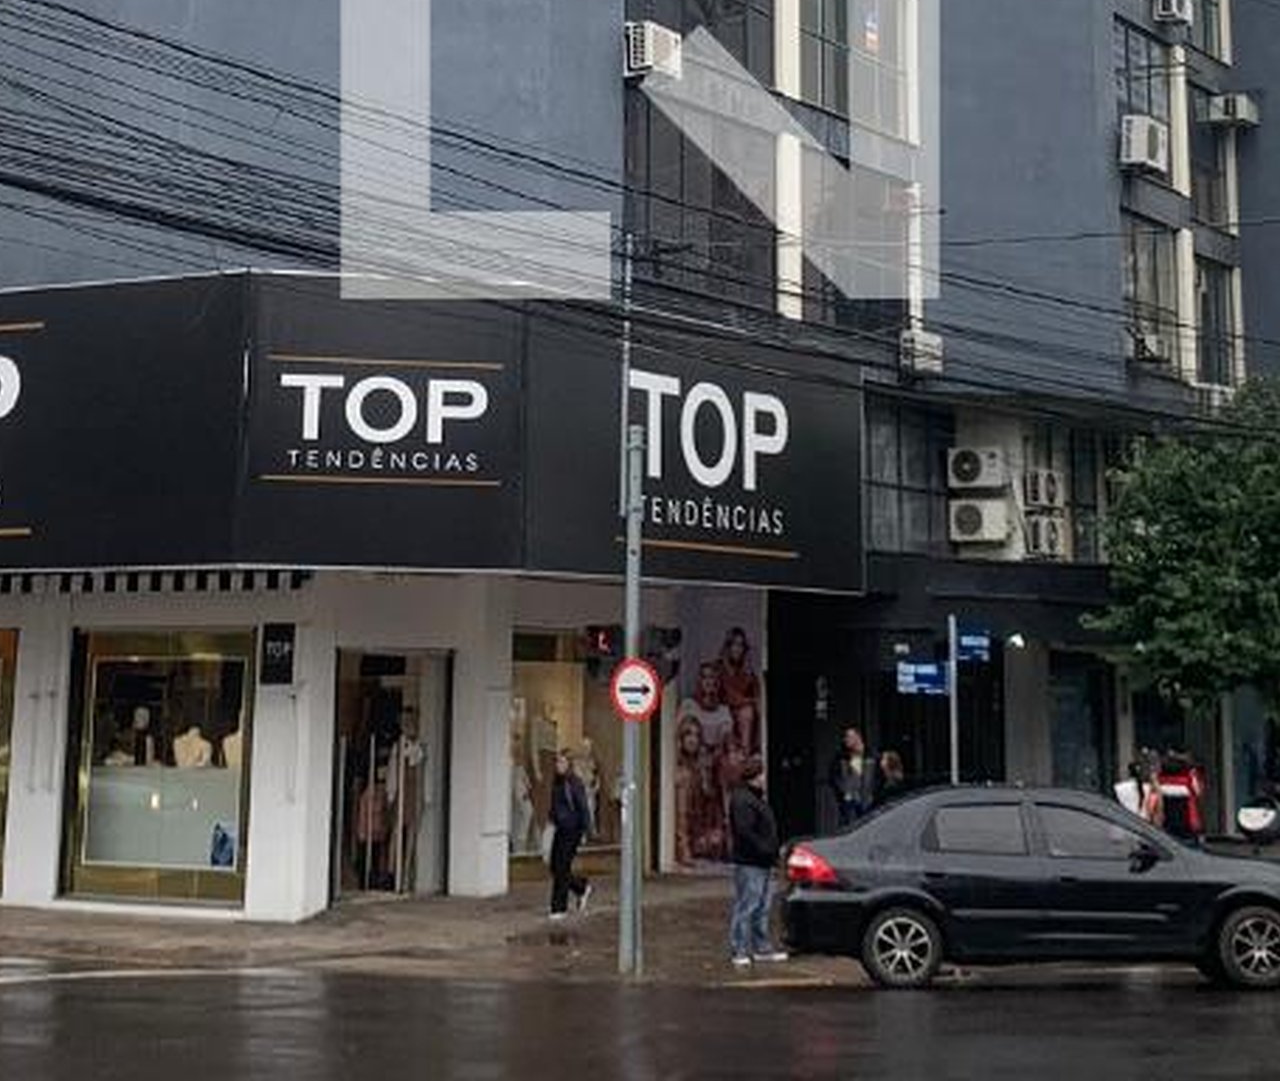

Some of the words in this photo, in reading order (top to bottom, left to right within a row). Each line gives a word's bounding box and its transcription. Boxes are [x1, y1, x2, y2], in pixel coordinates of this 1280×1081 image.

[280, 374, 488, 444] TOP
[629, 369, 788, 491] TOP
[286, 446, 480, 471] TENDÊNCIAS
[641, 494, 784, 534] ENDÊNCIAS
